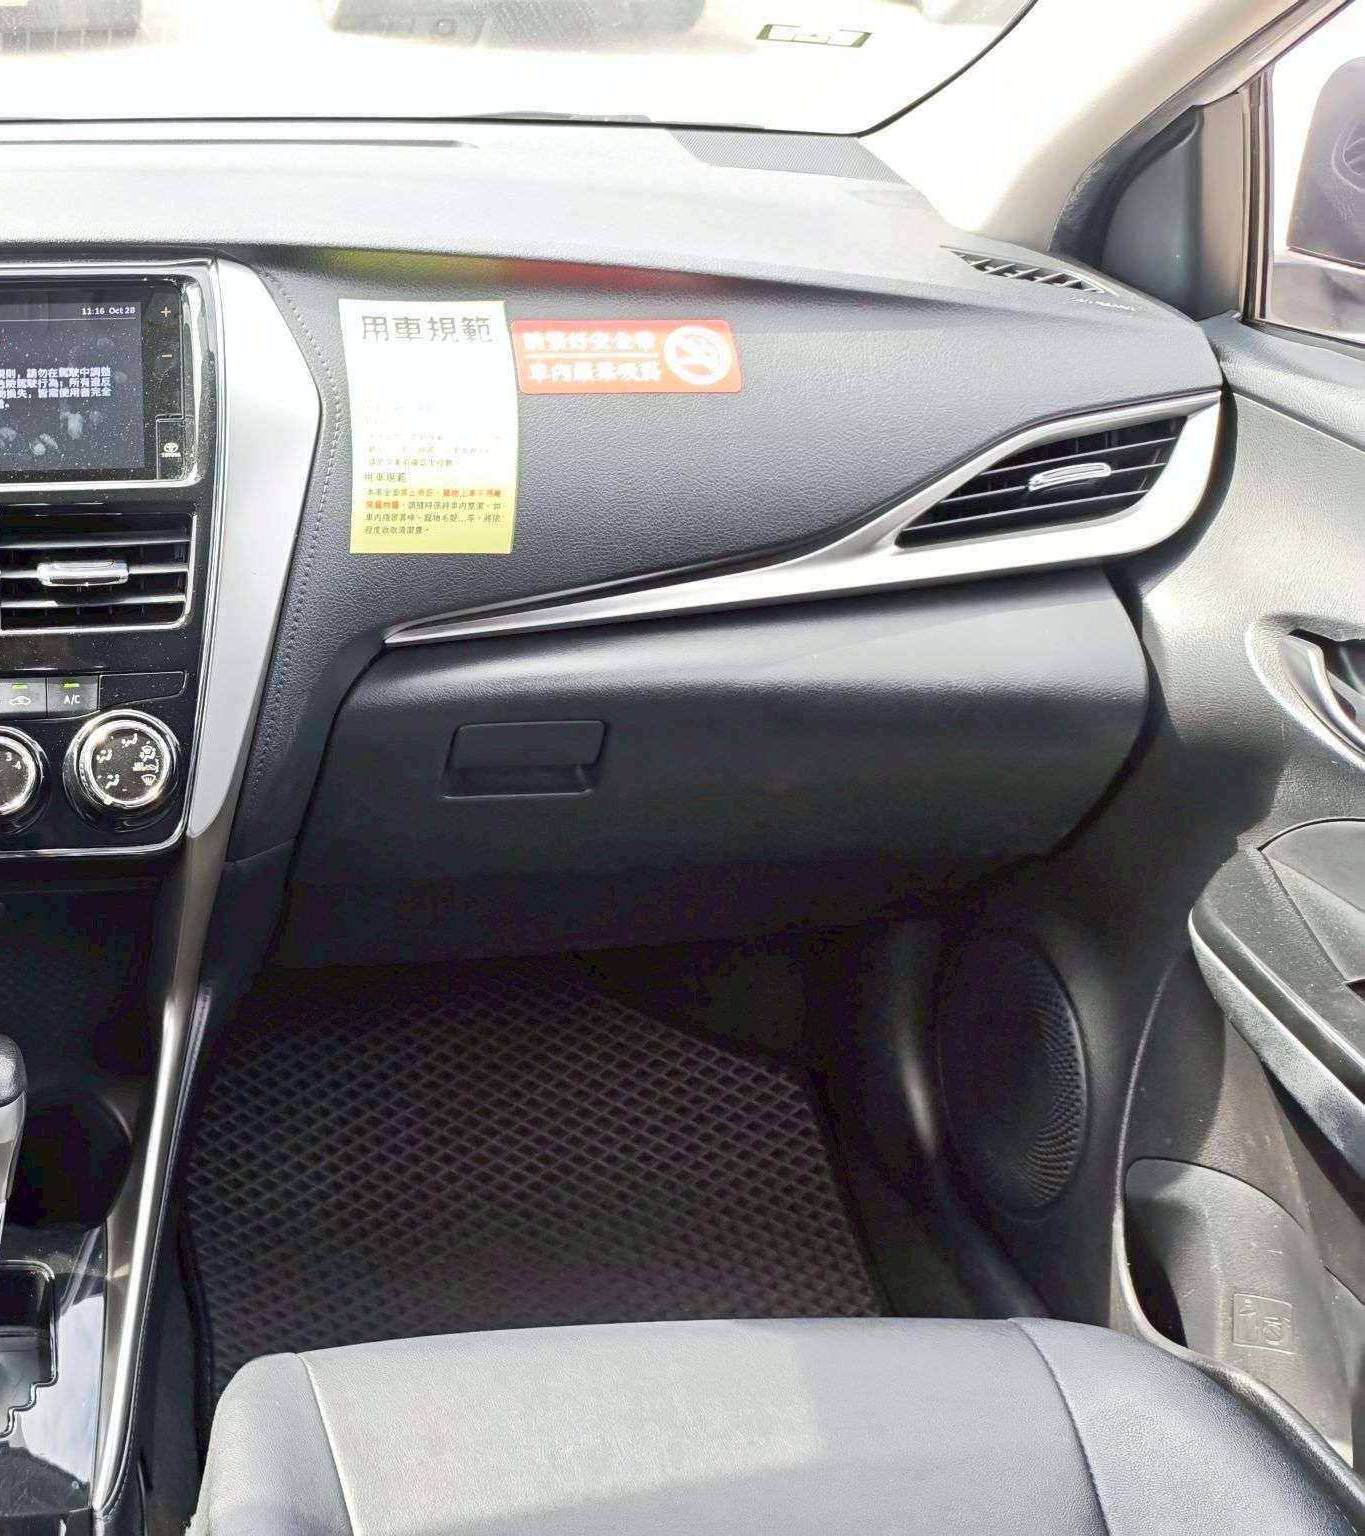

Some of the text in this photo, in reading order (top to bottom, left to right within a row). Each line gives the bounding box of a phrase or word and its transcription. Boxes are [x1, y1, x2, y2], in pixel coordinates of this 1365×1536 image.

[81, 306, 136, 316] 11:16 Oct 28
[362, 315, 492, 343] 用車規範
[63, 694, 81, 705] A/C
[5, 752, 12, 762] 3
[13, 760, 22, 770] 4
